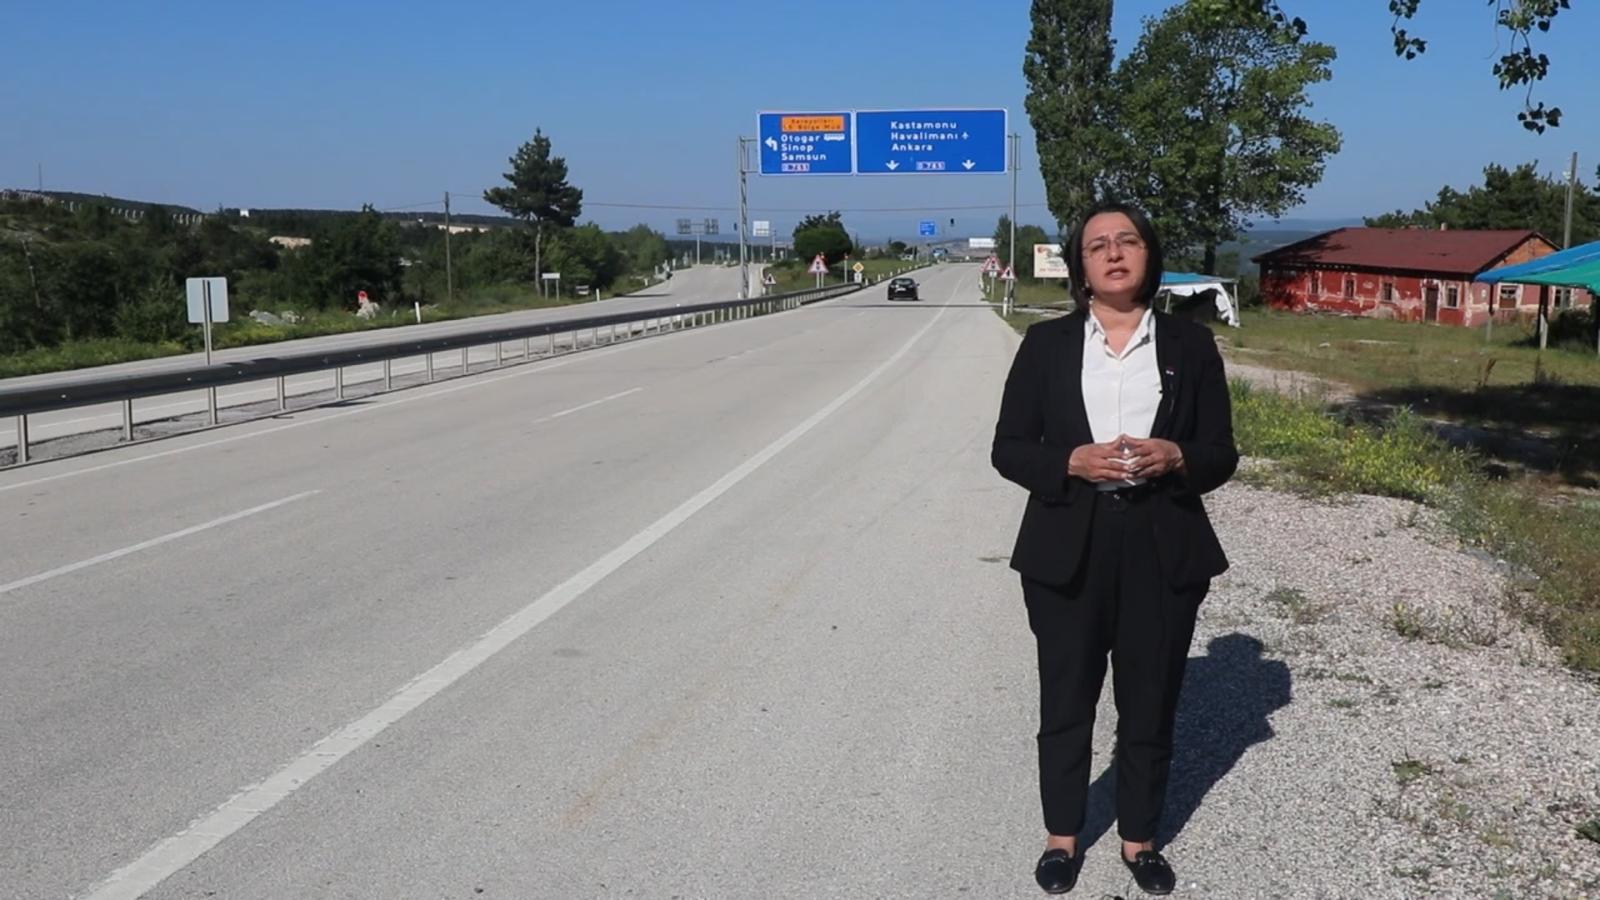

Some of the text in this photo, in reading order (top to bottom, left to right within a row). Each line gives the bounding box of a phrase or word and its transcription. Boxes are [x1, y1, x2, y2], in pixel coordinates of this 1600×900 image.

[890, 121, 957, 130] Kastamonu
[780, 134, 821, 143] Otogar
[890, 132, 958, 140] Havalimanı
[781, 144, 814, 153] Sinop
[891, 143, 933, 151] Ankara
[781, 153, 827, 161] Samsun
